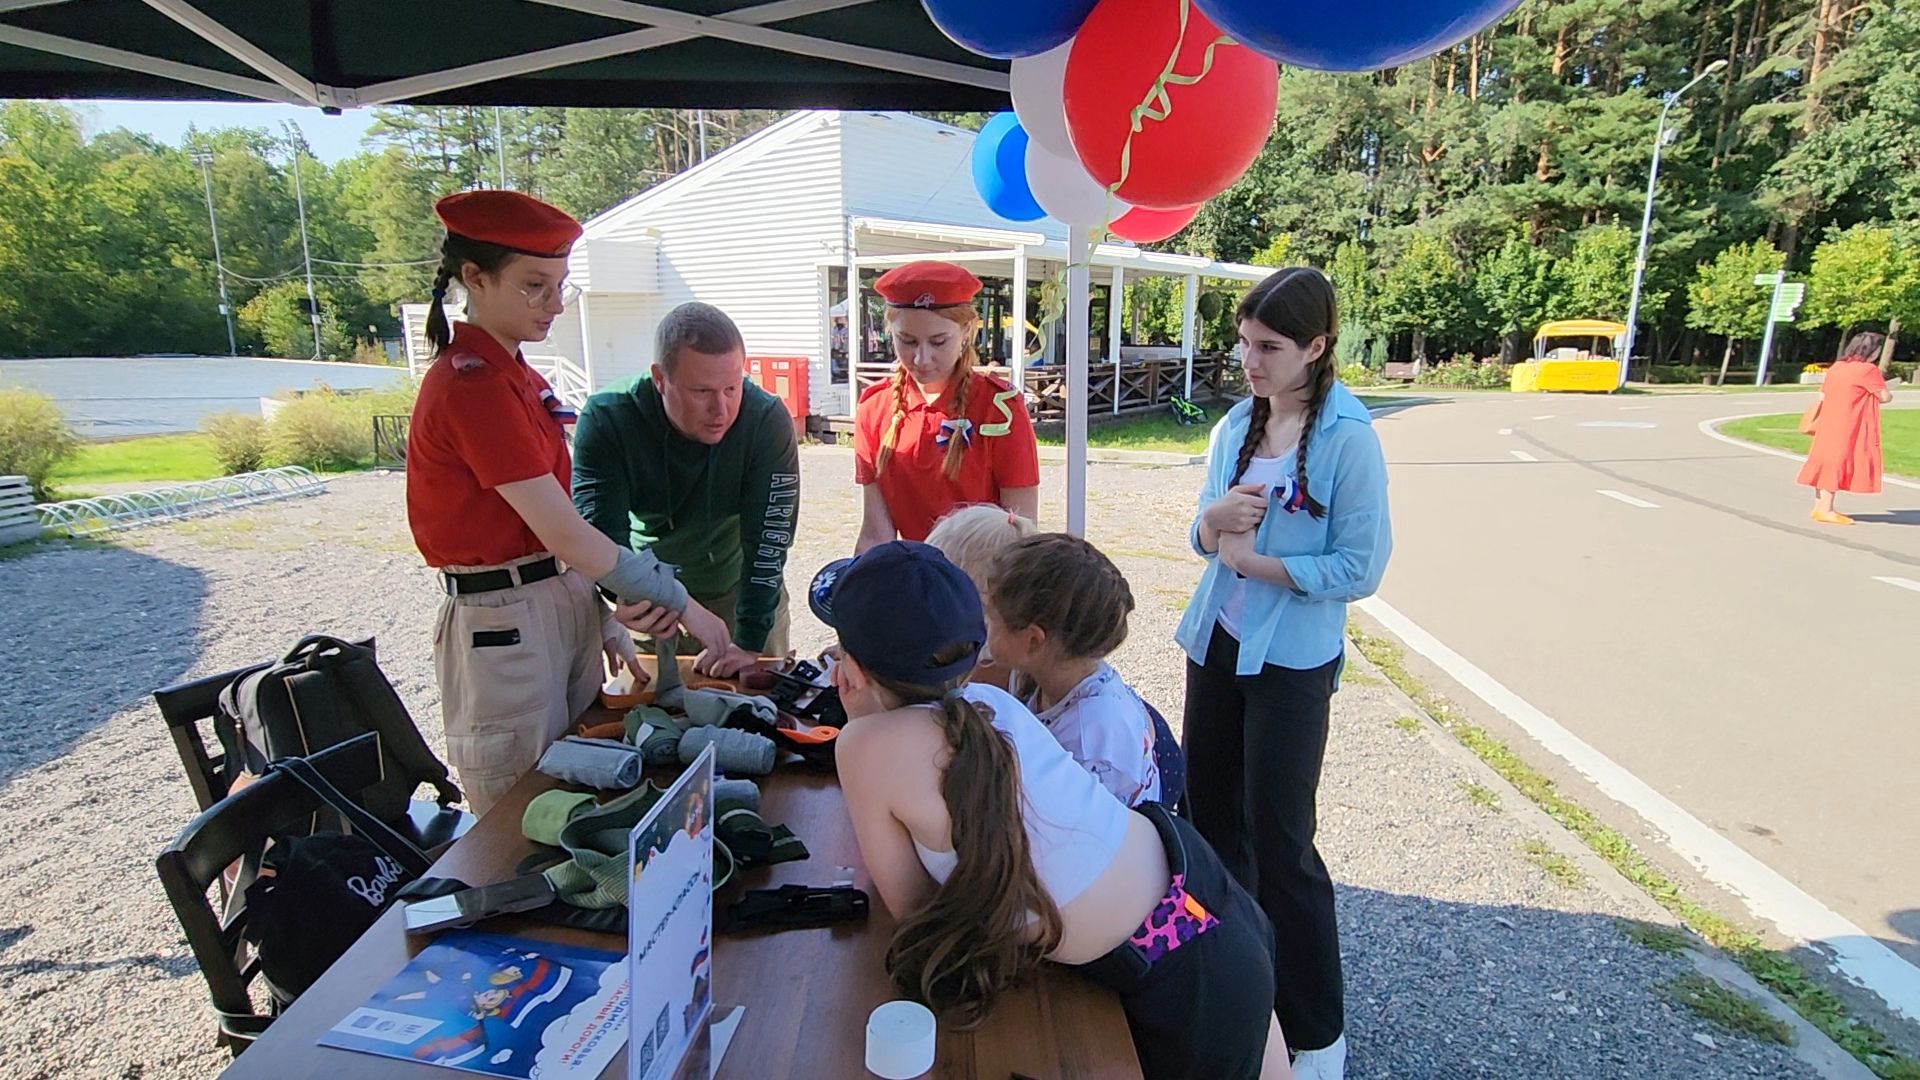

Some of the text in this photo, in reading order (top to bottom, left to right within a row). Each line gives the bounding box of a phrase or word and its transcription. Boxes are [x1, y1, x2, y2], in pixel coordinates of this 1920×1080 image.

[750, 473, 798, 588] ALRIGHTY
[346, 856, 403, 907] Barbi
[595, 978, 632, 1021] ОПАСНЫЕ
[561, 1023, 598, 1064] ДОРОГИ!
